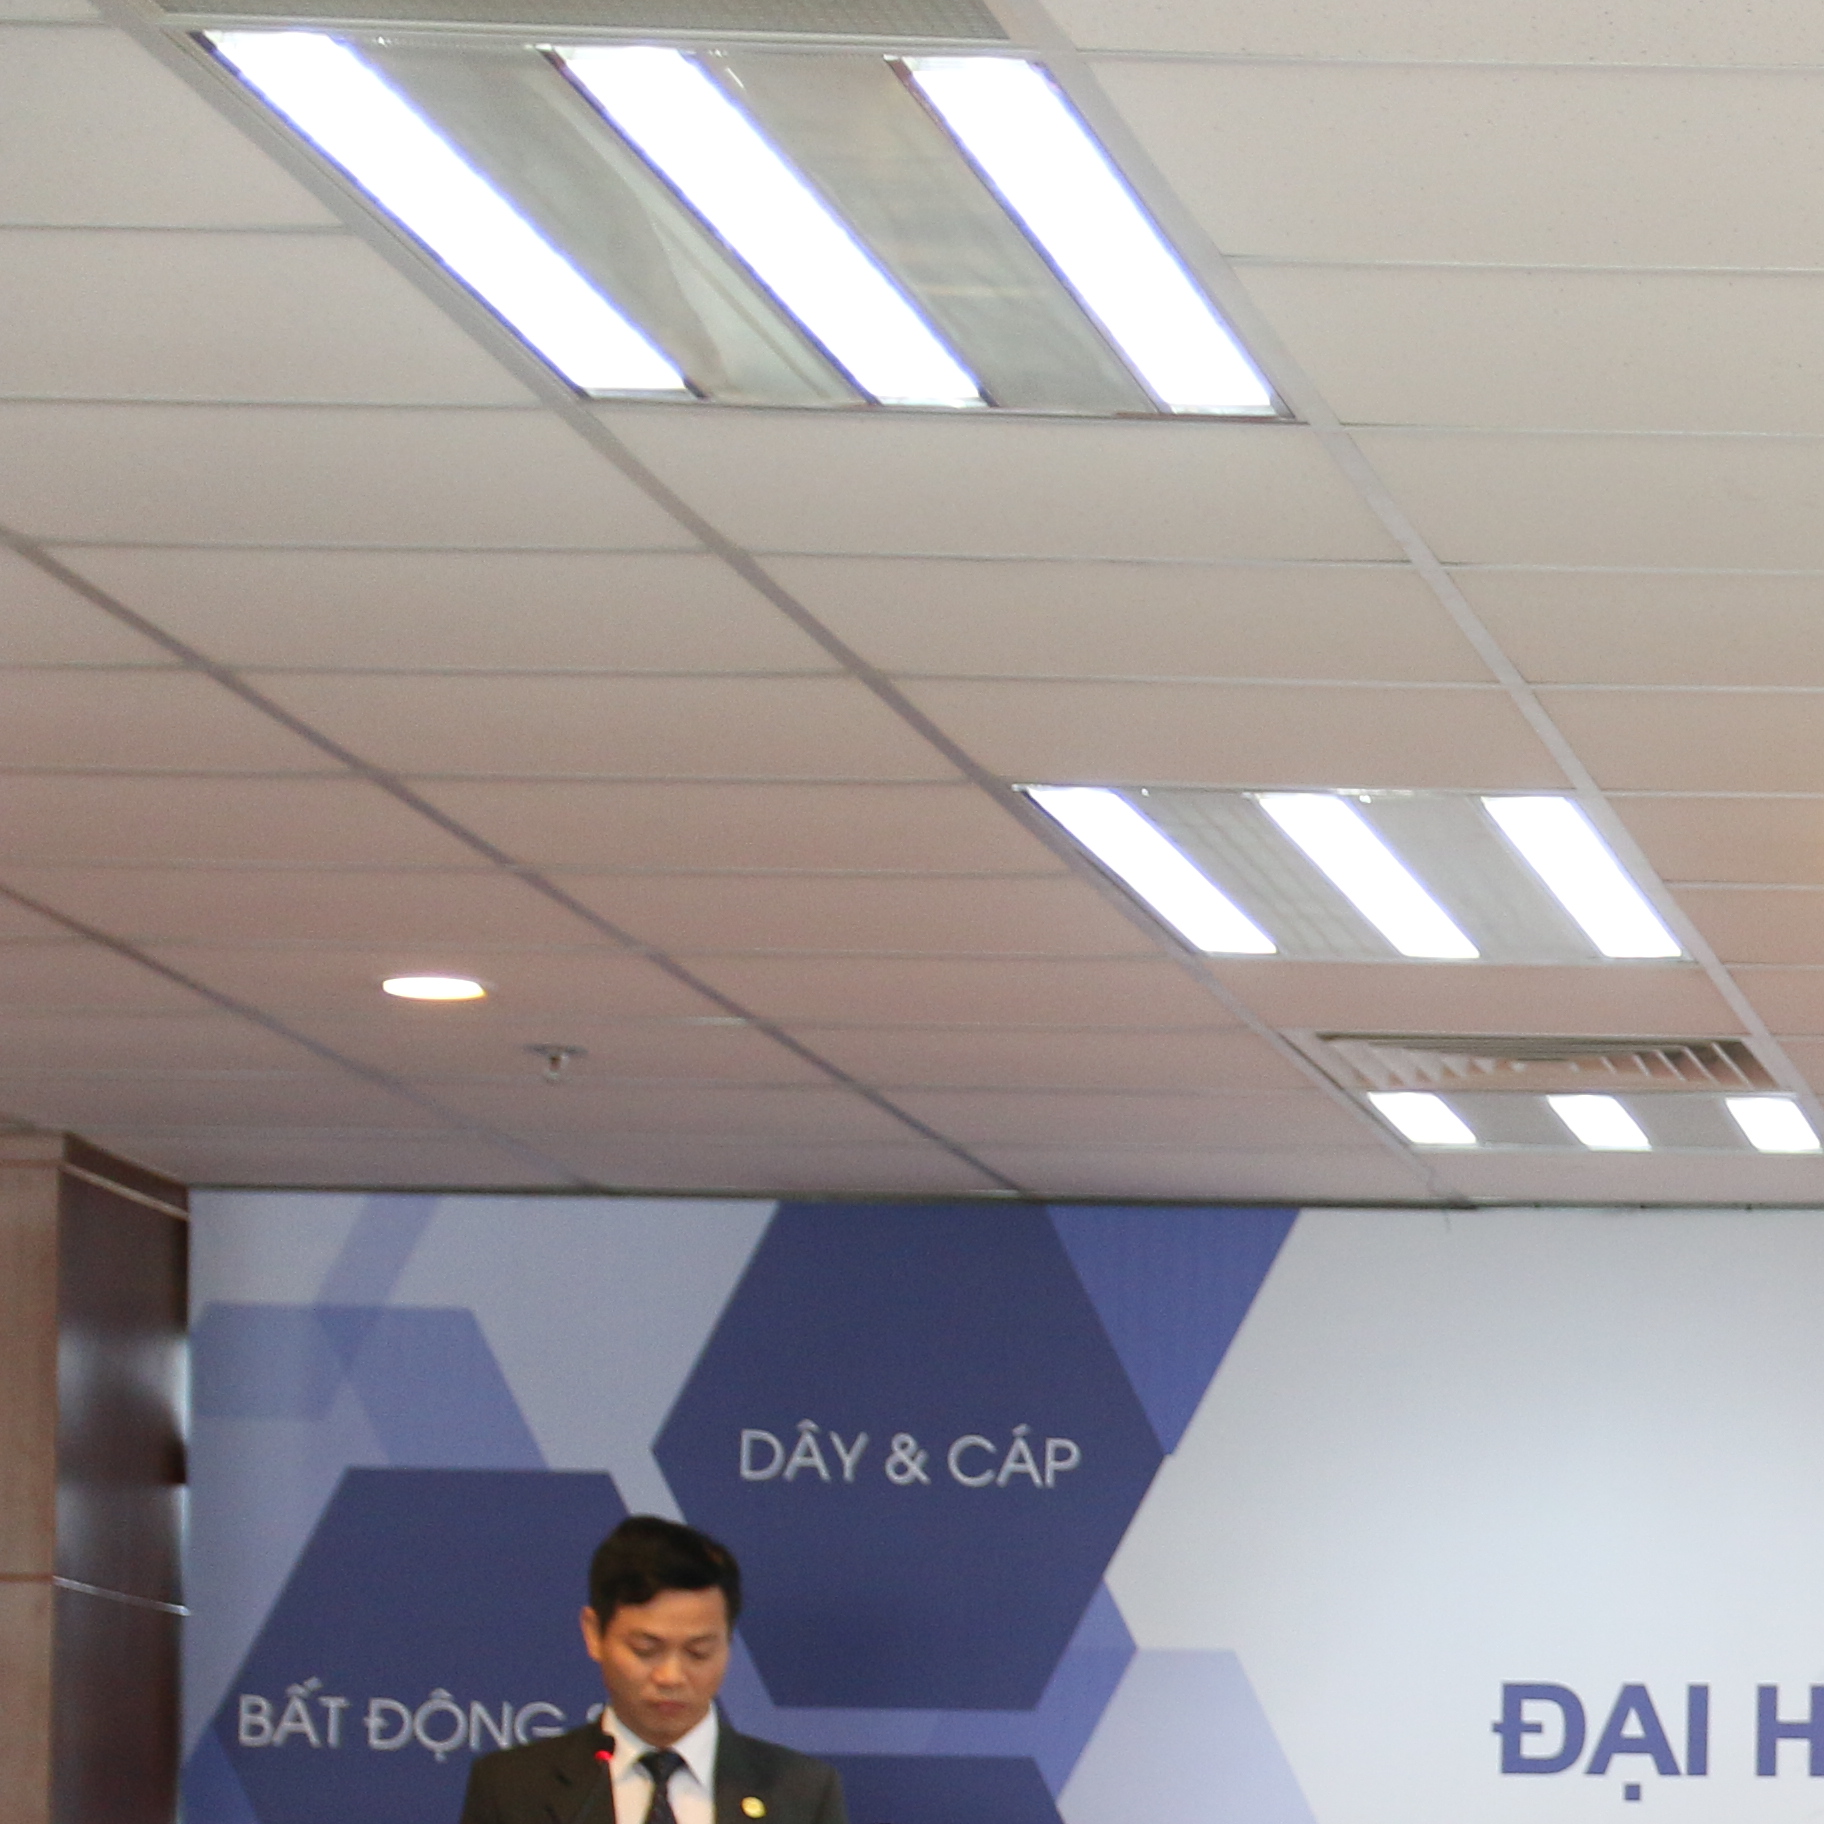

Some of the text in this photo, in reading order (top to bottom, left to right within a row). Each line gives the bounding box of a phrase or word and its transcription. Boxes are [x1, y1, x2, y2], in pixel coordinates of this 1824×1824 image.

[740, 1418, 1081, 1490] DÂY & CÁP
[238, 1676, 567, 1762] BẤT ĐỘNG
[1492, 1681, 1710, 1803] ĐẠI
